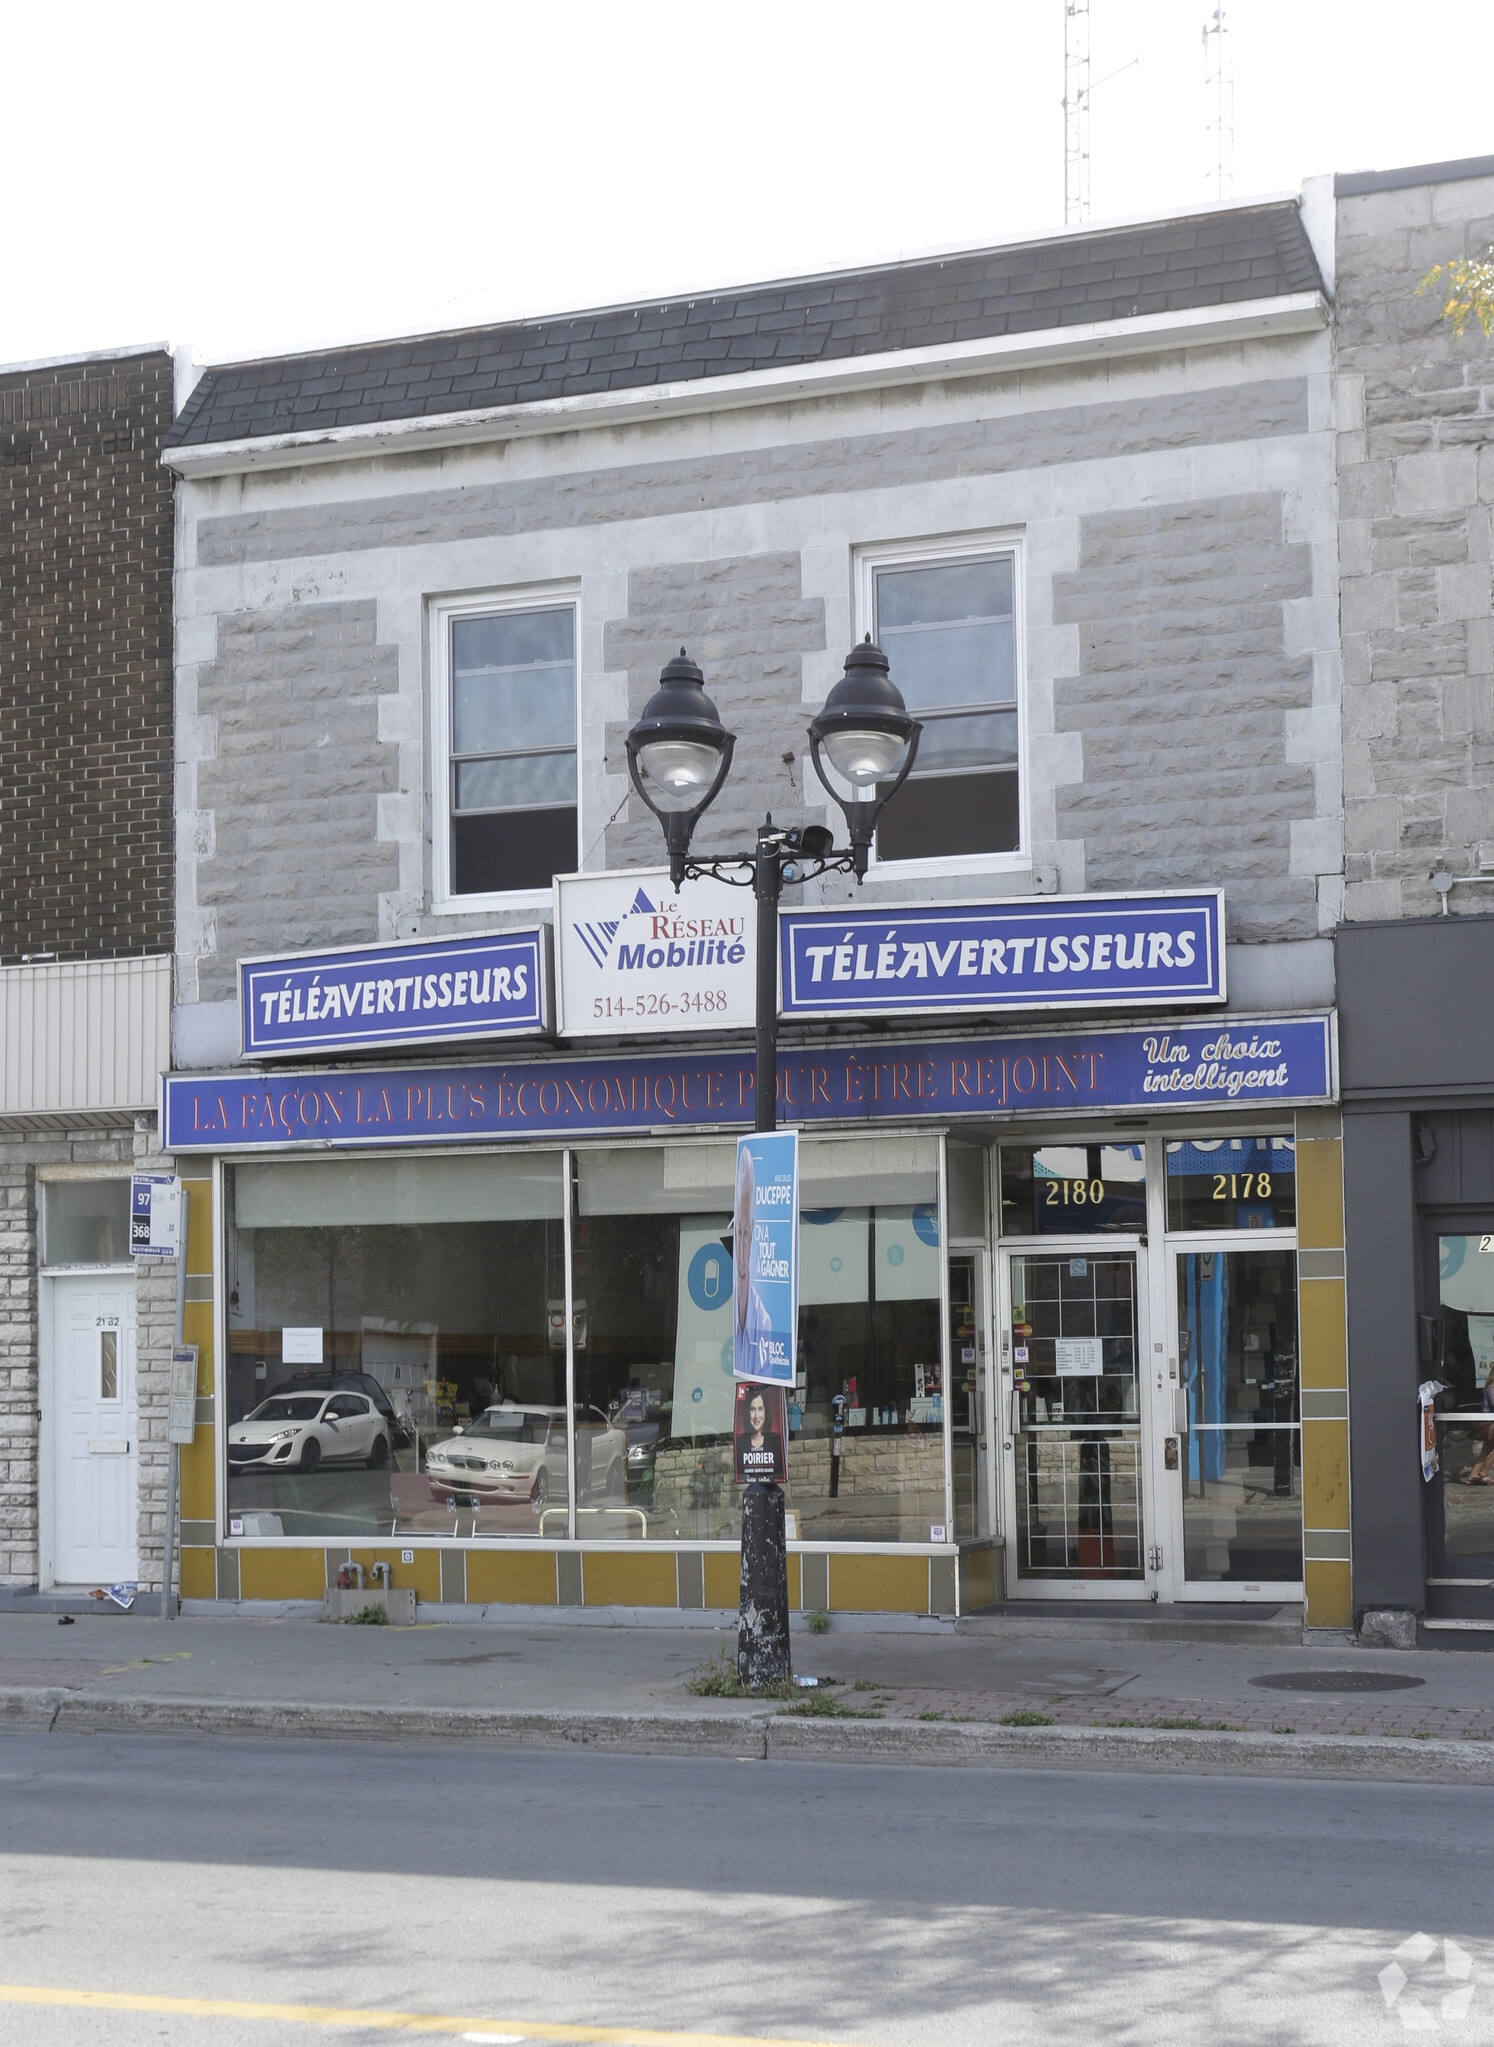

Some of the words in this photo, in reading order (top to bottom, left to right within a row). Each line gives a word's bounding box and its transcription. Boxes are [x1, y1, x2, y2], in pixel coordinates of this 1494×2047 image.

[659, 901, 678, 913] Le
[650, 915, 746, 940] RÉSEAU
[617, 936, 746, 971] Mobilité
[805, 929, 1197, 983] TÉLÉAVERTISSEURS
[260, 965, 528, 1026] TÉLÉAVERTISSEURS
[593, 990, 728, 1018] 514-526-3488
[1142, 1036, 1190, 1064] Un
[1201, 1033, 1282, 1062] choix
[1142, 1061, 1289, 1097] intelligent
[193, 1096, 230, 1130] LA
[241, 1090, 345, 1137] FAÇON
[355, 1088, 394, 1123] LA
[405, 1081, 486, 1121] PLUS
[497, 1071, 726, 1118] ÉCONOMIQUE
[737, 1066, 832, 1106] PUR
[844, 1055, 938, 1101] ÊTRE
[950, 1052, 1105, 1106] REJOINT
[755, 1185, 791, 1205] DUCEPPE
[1046, 1179, 1105, 1205] 2180
[1212, 1172, 1272, 1199] 2178
[137, 1192, 151, 1206] 97
[132, 1225, 150, 1238] 368
[1480, 1236, 1491, 1251] 2
[759, 1242, 776, 1259] TOUT
[760, 1260, 789, 1278] GAGNER
[768, 1341, 785, 1354] BLOC
[743, 1452, 775, 1465] POIRIER
